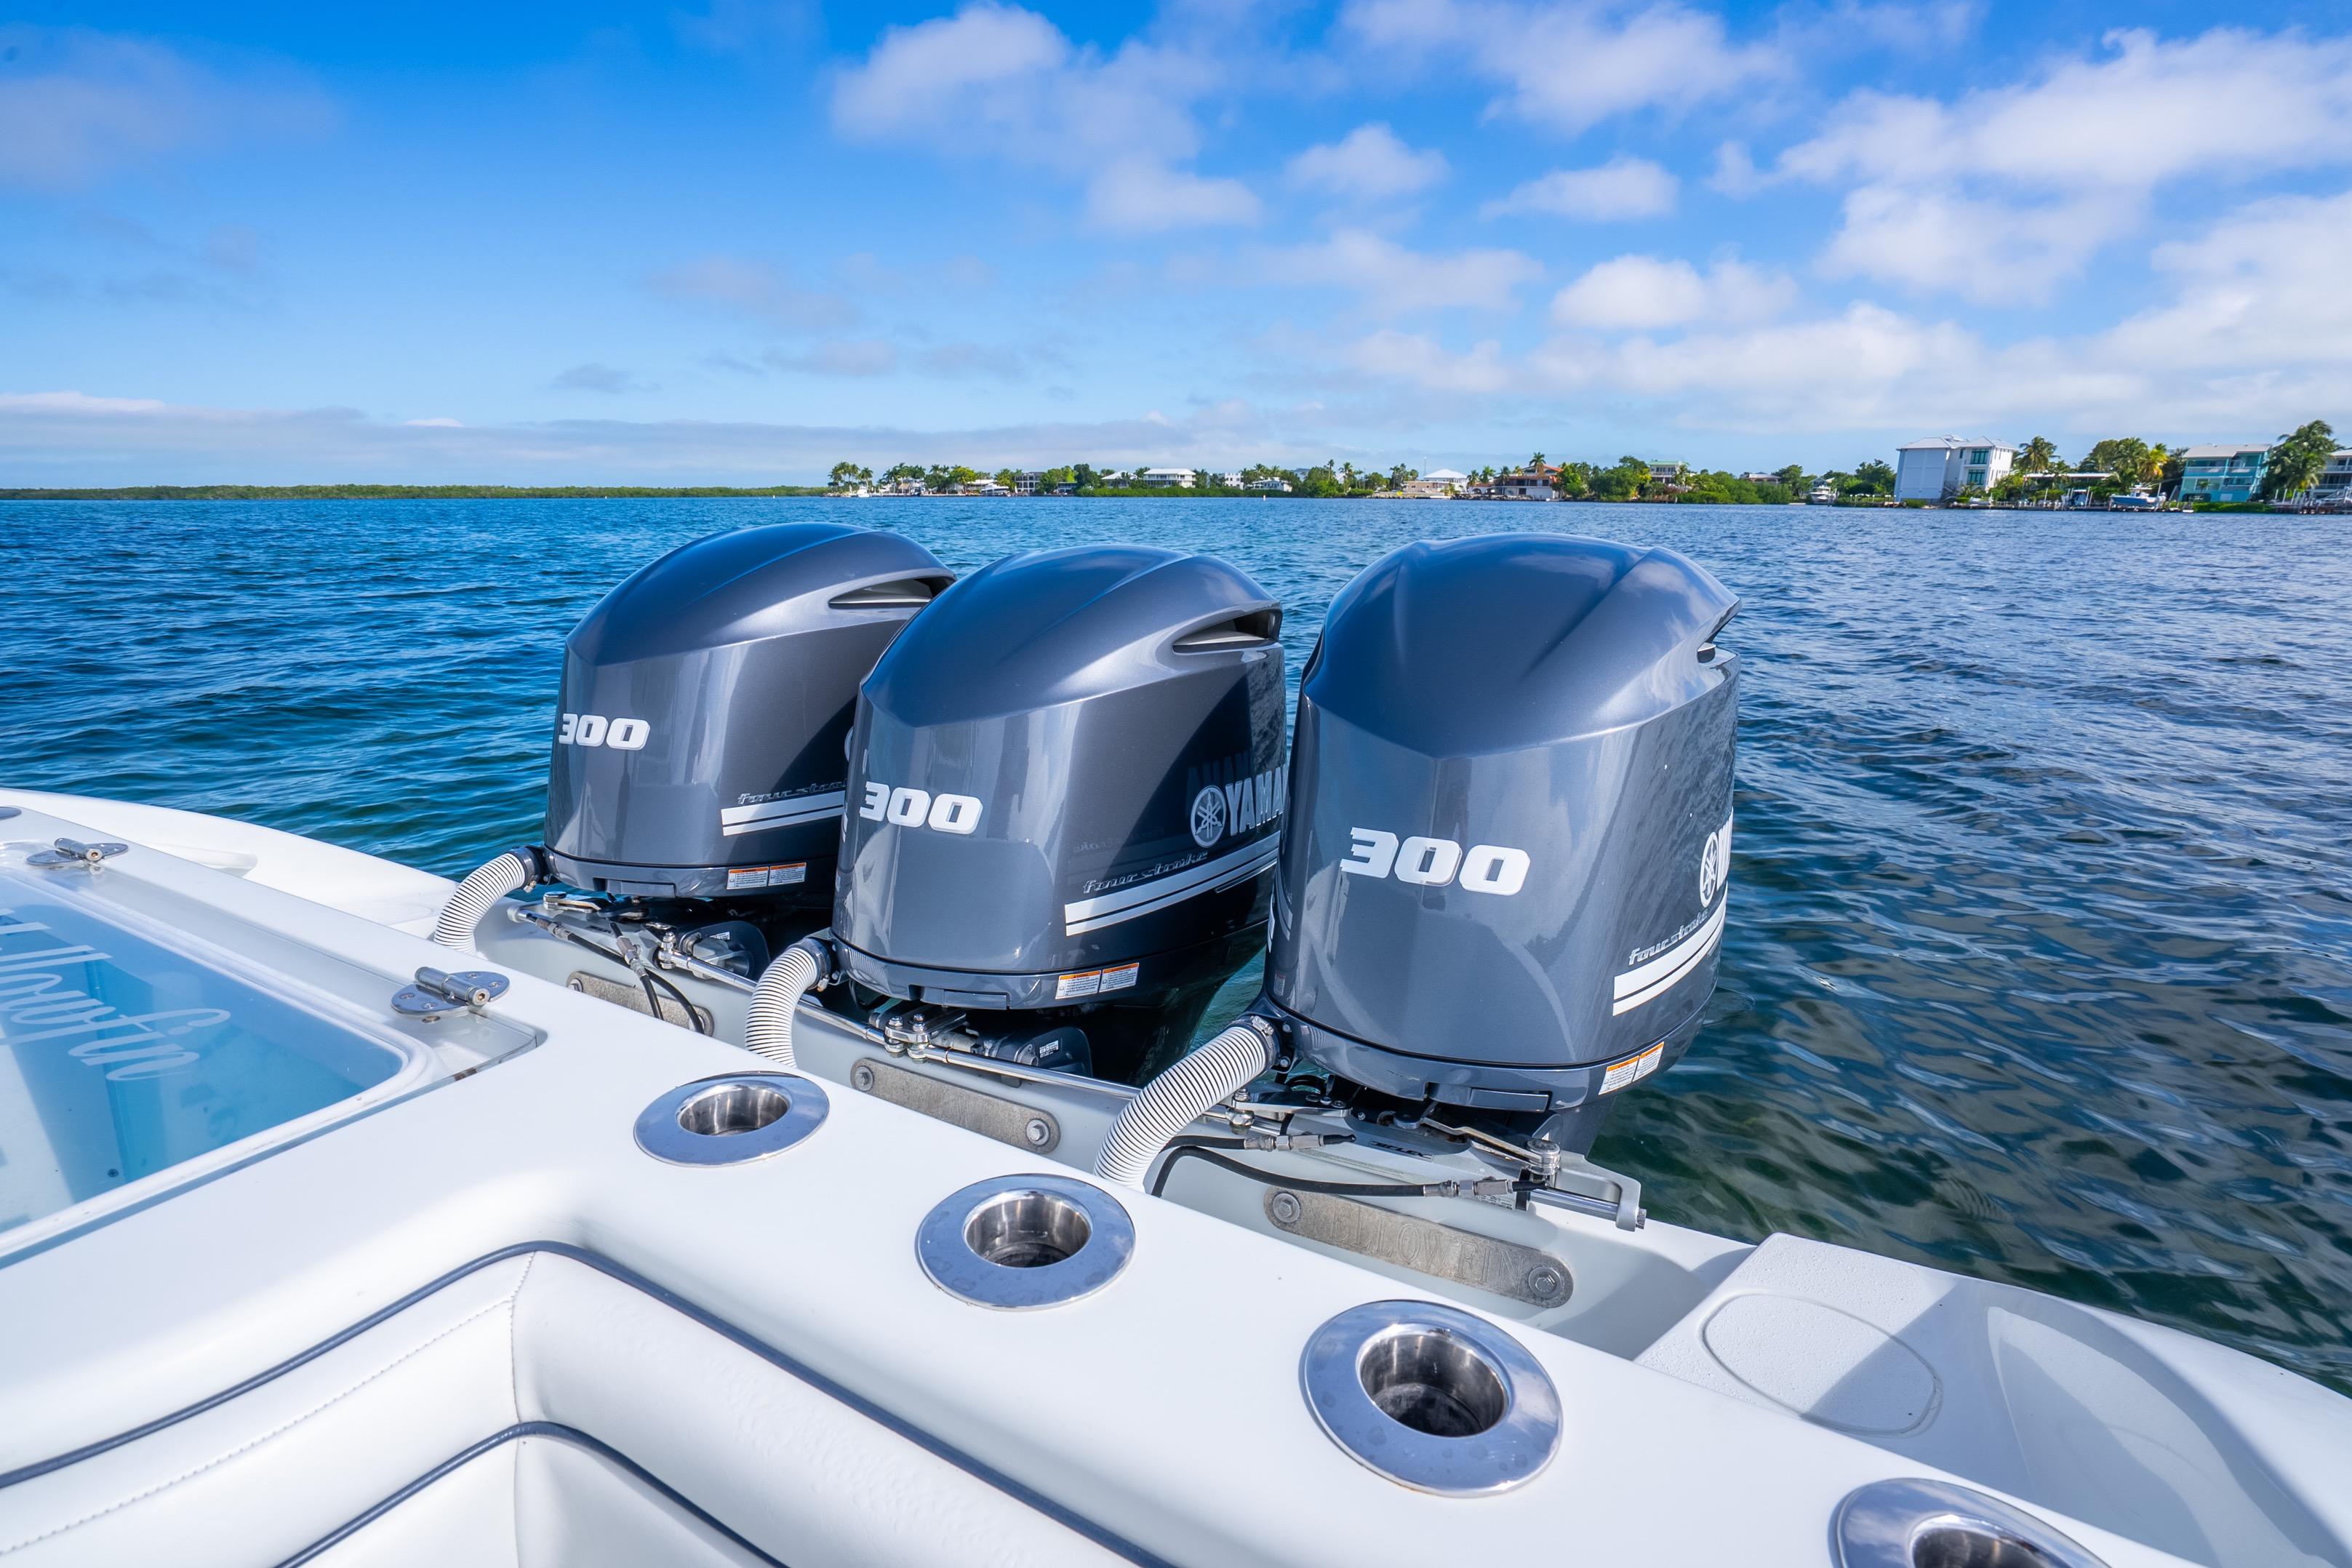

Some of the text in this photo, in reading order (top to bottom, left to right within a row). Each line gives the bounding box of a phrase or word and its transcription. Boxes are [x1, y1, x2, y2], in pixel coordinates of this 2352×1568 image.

[559, 713, 651, 751] 300
[859, 781, 983, 835] 300
[1225, 764, 1289, 836] YAMA
[1340, 827, 1530, 896] 300
[1309, 1199, 1526, 1294] YELLOWFIN
